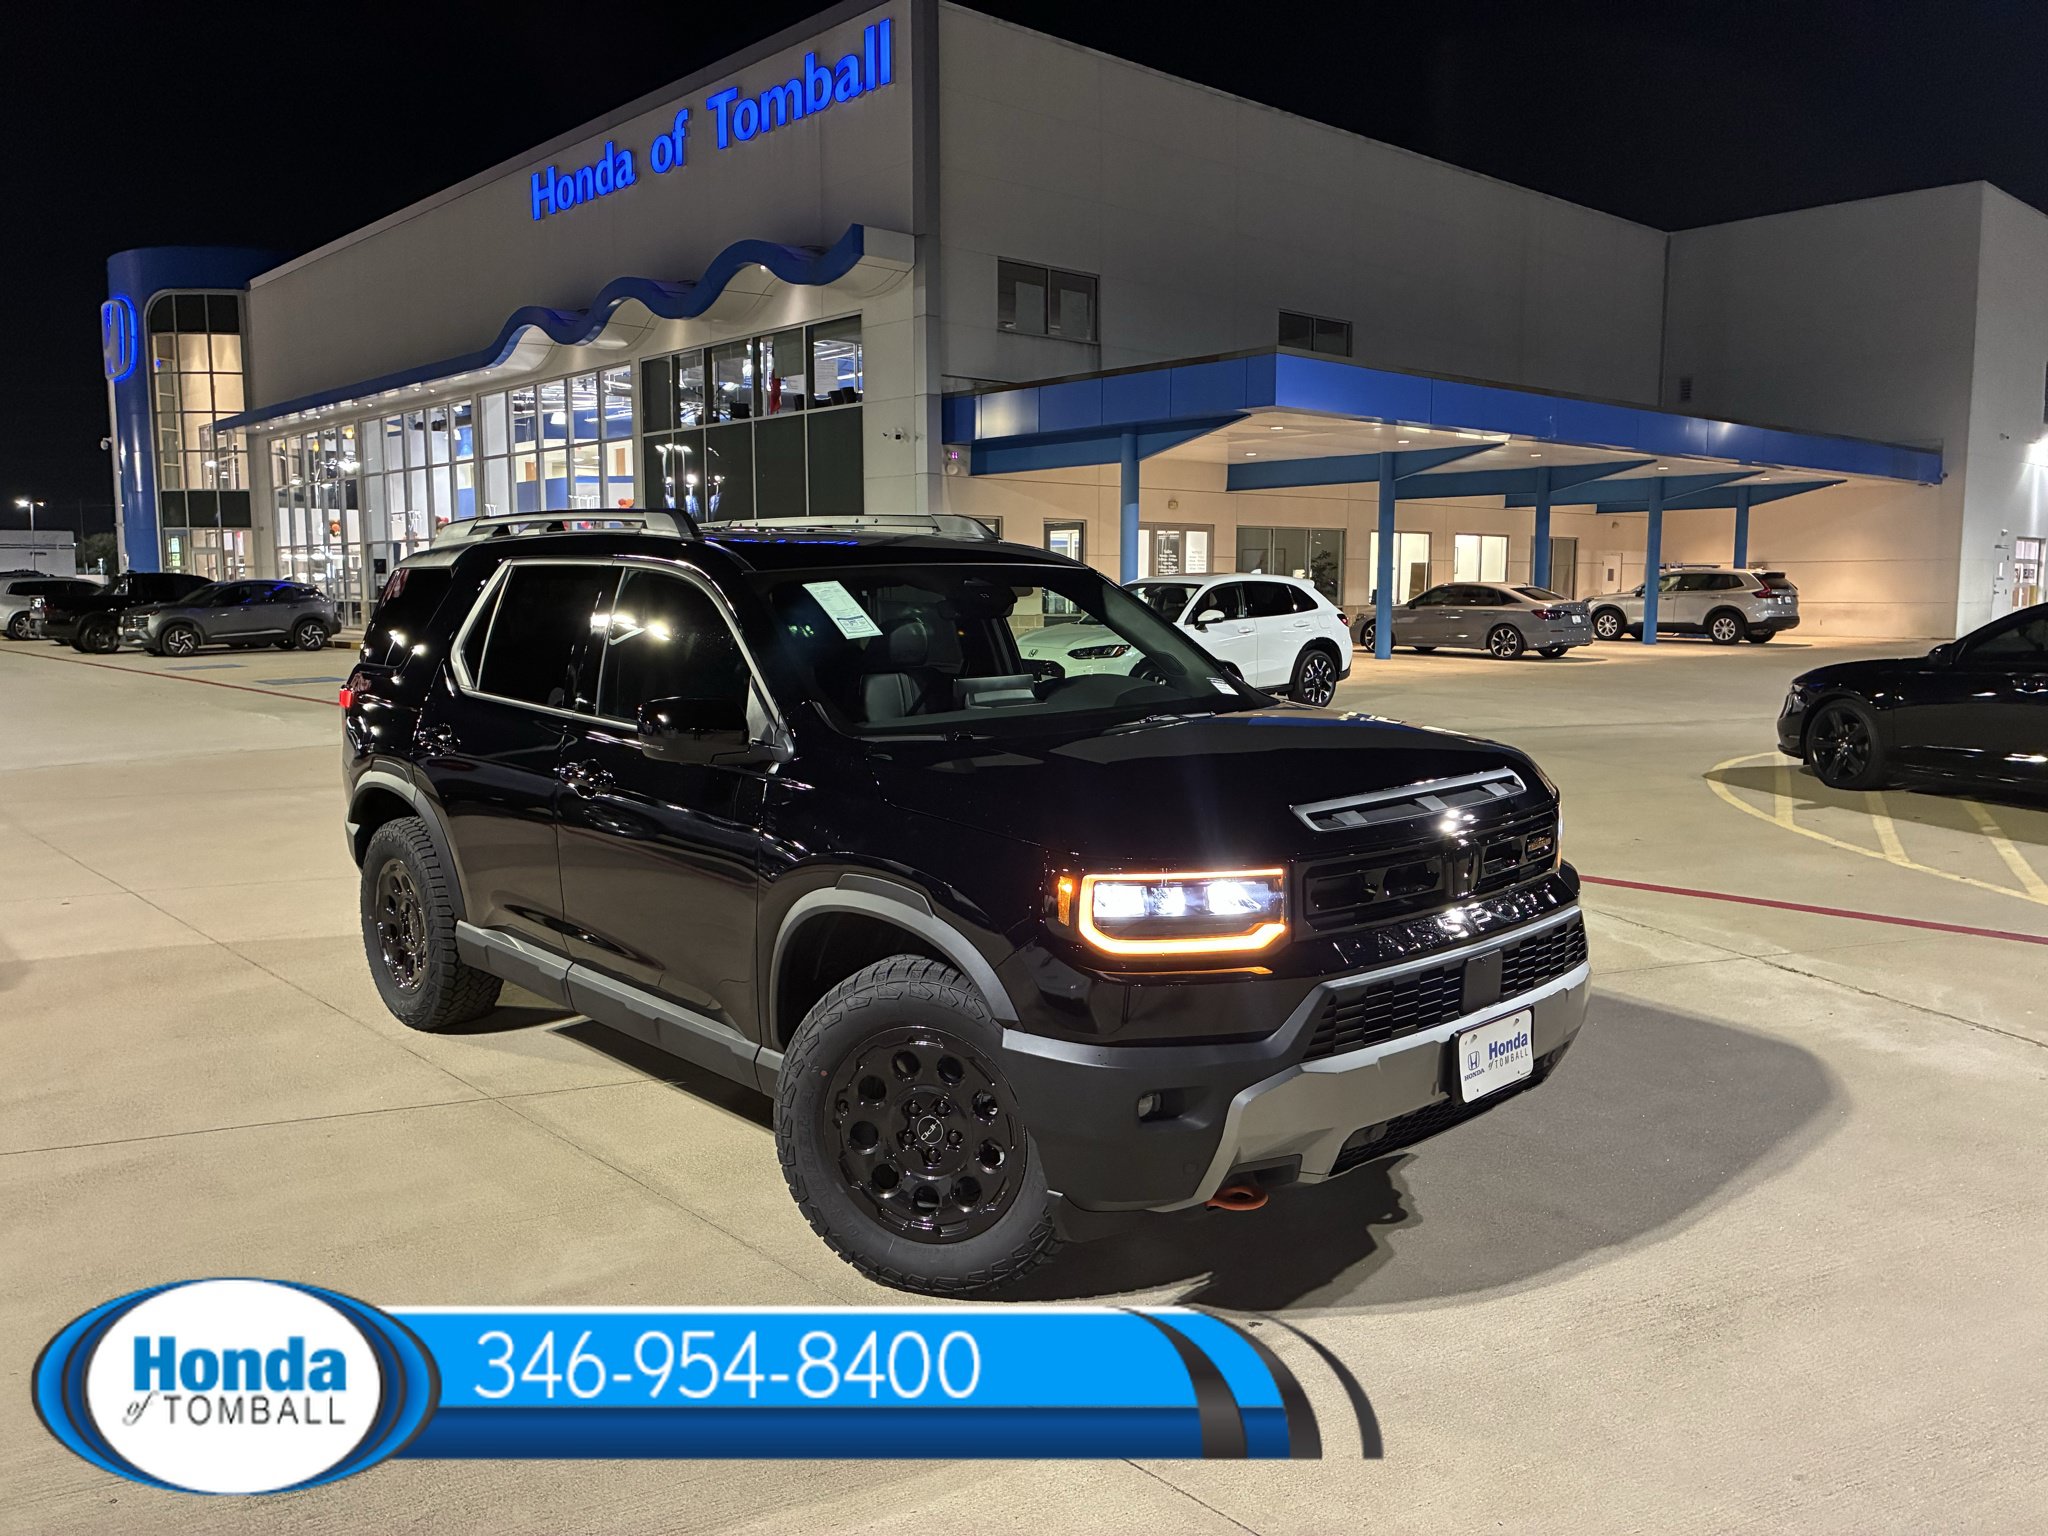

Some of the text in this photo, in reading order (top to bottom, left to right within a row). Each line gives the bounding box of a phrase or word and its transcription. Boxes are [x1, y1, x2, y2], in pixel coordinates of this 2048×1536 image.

[531, 18, 892, 220] Honda of Tomball
[1489, 1032, 1528, 1060] Honda
[1488, 1048, 1528, 1070] of TOMBALL
[1464, 1068, 1485, 1081] HONDA
